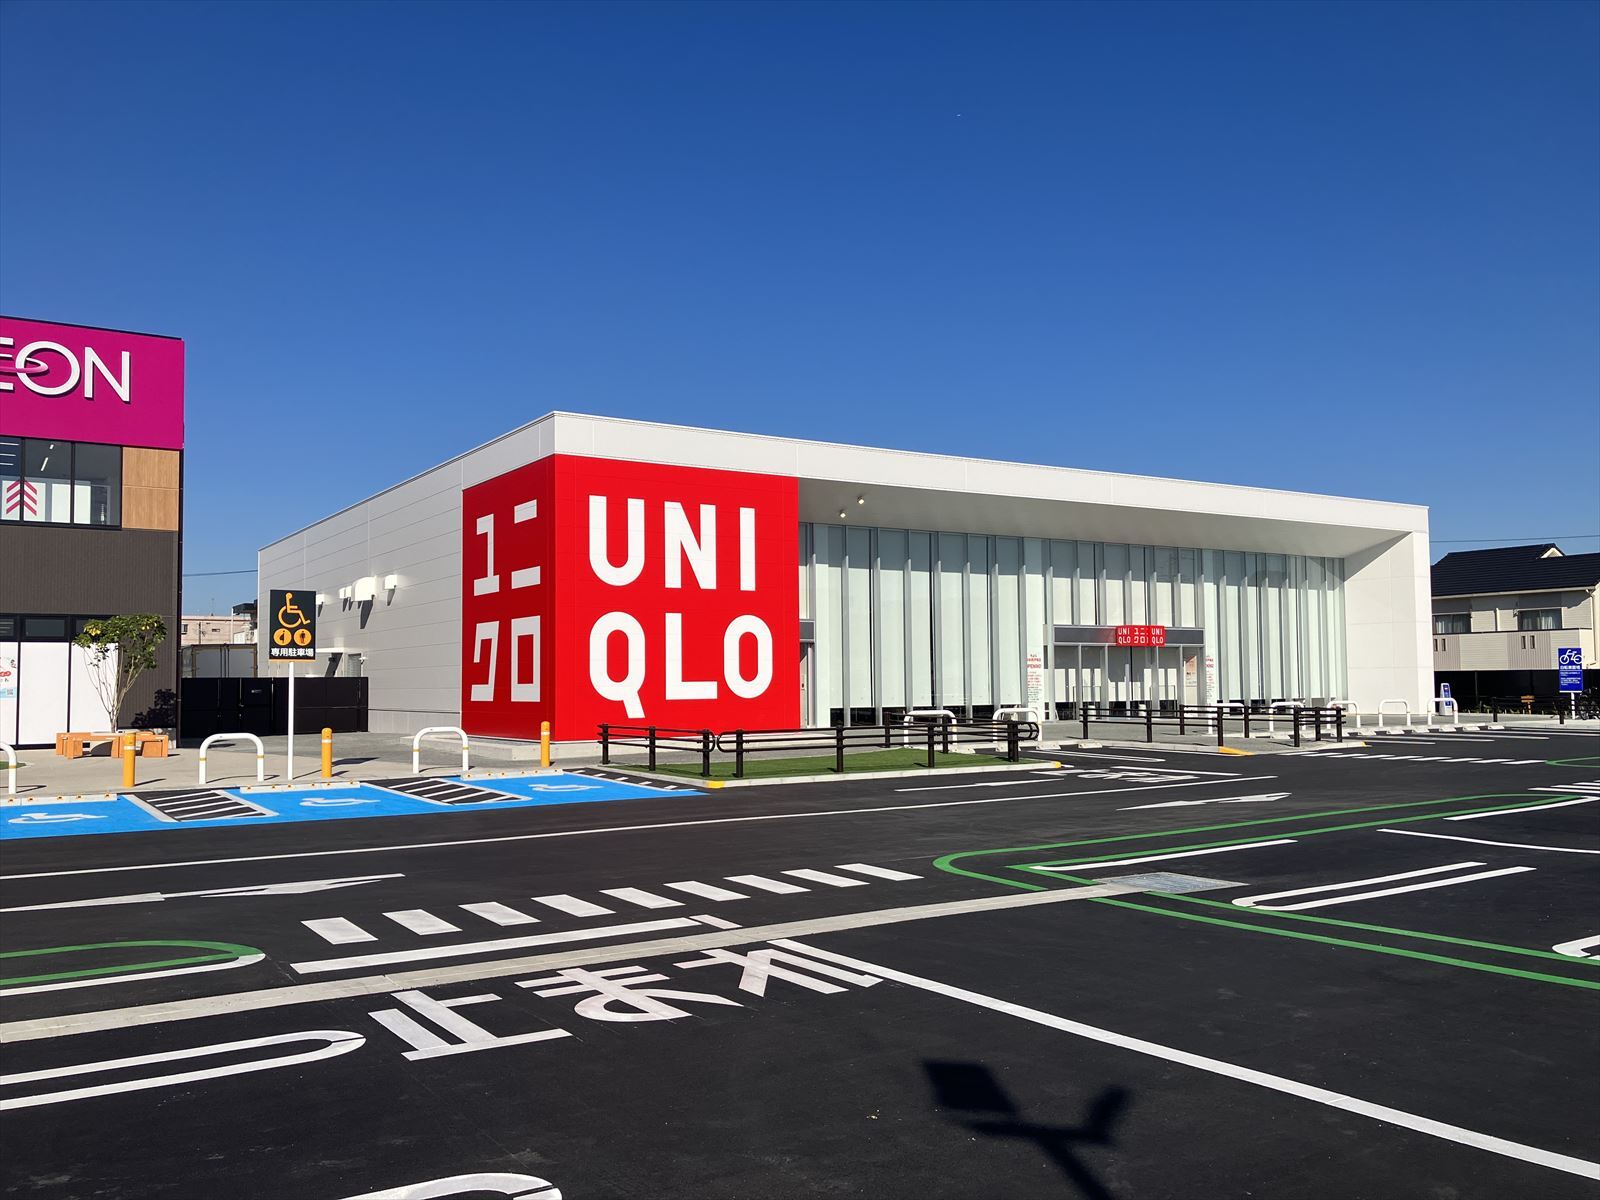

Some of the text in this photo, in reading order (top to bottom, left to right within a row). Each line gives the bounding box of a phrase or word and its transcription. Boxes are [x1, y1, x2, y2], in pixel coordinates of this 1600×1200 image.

[474, 499, 540, 596] ユニ
[589, 495, 756, 591] UNI
[270, 647, 314, 657] 専用駐車場
[470, 615, 541, 702] クロ
[589, 611, 773, 719] QLO
[1118, 636, 1131, 644] QLO
[1151, 636, 1164, 644] QLO
[367, 948, 884, 1062] 止まれ
